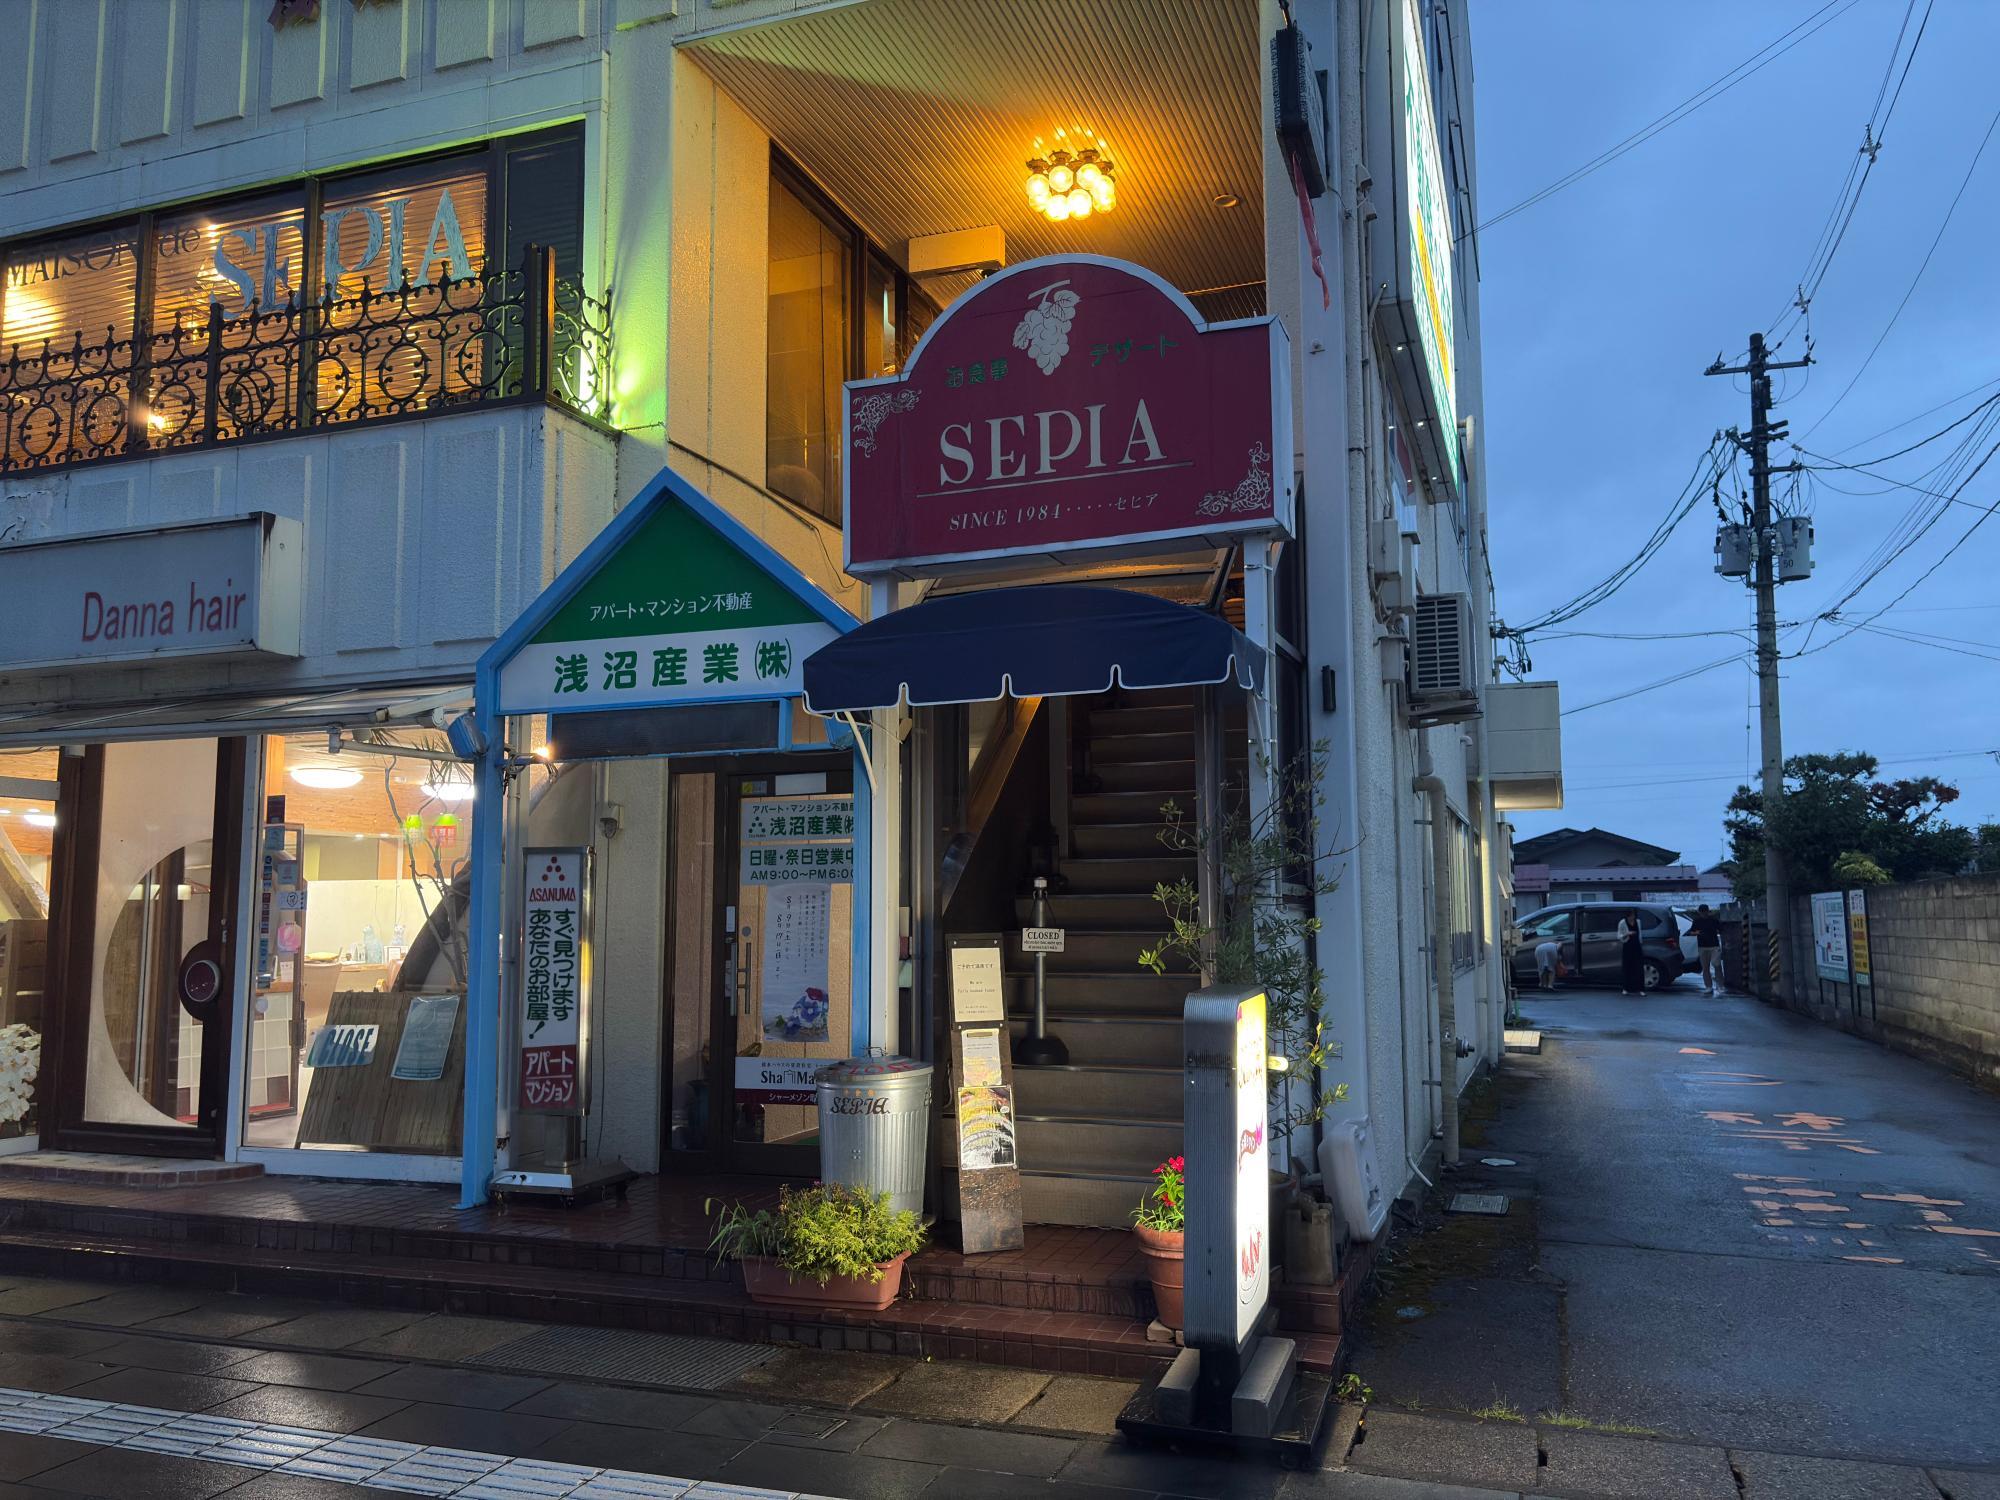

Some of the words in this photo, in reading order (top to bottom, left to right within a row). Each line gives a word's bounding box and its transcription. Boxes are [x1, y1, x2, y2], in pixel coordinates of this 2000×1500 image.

[6, 231, 140, 289] MAISON
[158, 223, 201, 258] de
[208, 188, 476, 321] SEPIA
[944, 358, 1009, 388] お食事
[938, 398, 1167, 487] SEPIA
[948, 509, 1008, 531] SINCE
[81, 590, 175, 643] Danna
[187, 578, 247, 634] hair
[588, 591, 753, 622] アパート・マンション不動産
[553, 637, 792, 694] 浅沼産業(株)
[528, 887, 577, 902] ASANUMA
[1027, 931, 1060, 940] CLOSED
[552, 908, 576, 1022] すぐ見つけます
[318, 1027, 375, 1065] CLOSE
[525, 1050, 574, 1076] アパート
[525, 1080, 574, 1104] マンション
